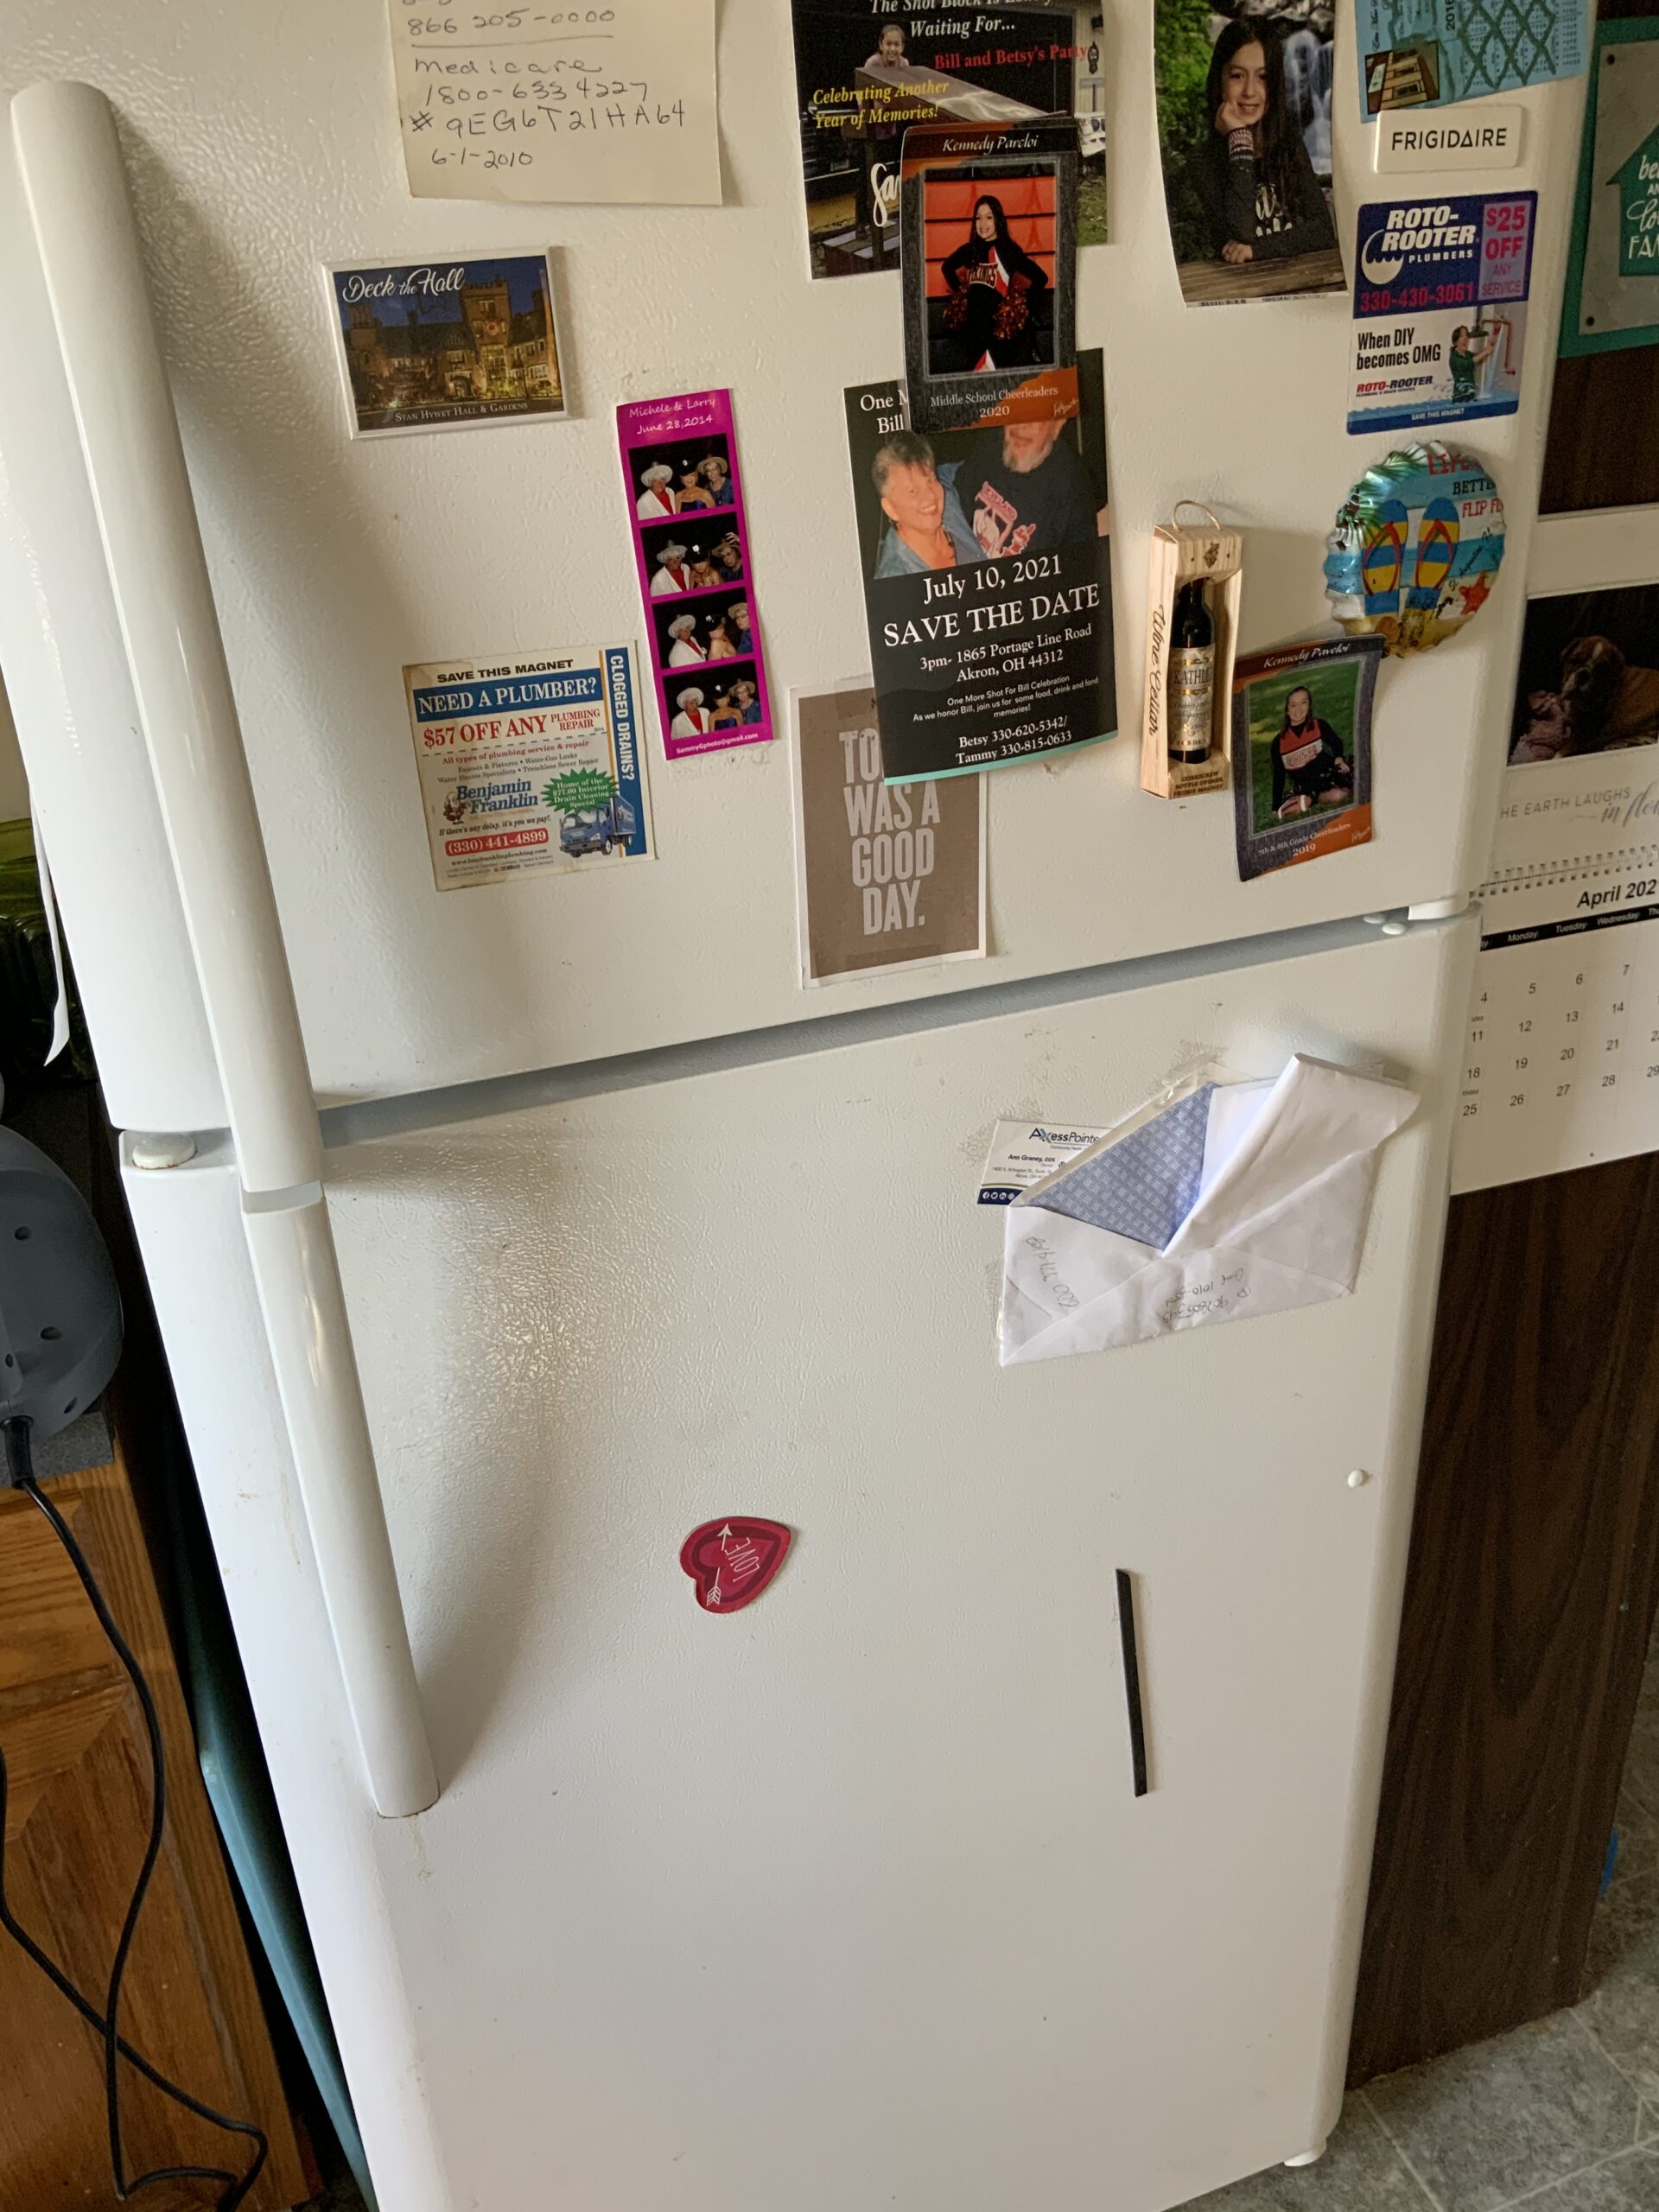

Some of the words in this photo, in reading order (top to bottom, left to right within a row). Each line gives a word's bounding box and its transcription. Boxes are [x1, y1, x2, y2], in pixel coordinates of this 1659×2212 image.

[408, 18, 457, 35] 866
[473, 8, 615, 29] 205-0000
[911, 19, 969, 38] Waiting
[975, 16, 1014, 32] For...
[934, 54, 960, 70] Bill
[964, 52, 990, 67] and
[995, 47, 1045, 67] Betsy's
[1050, 44, 1088, 60] Party
[813, 85, 891, 105] Celebrating
[894, 80, 949, 98] Another
[815, 112, 847, 129] Year
[850, 110, 864, 127] of
[869, 105, 939, 123] Memories!
[943, 136, 993, 155] Kennedy
[1391, 129, 1507, 151] FRIGIDAIRE
[432, 149, 532, 168] 6-1-2010
[1386, 205, 1459, 230] ROTO-
[1485, 207, 1526, 232] $25
[1381, 225, 1477, 251] ROOTER
[1484, 236, 1522, 260] OFF
[1408, 250, 1473, 264] PLUMBERS
[1492, 264, 1512, 276] ANY
[343, 274, 395, 302] Deck
[398, 281, 416, 296] the
[414, 268, 465, 296] Hall
[1482, 280, 1521, 296] SERVICE
[1360, 282, 1474, 312] 330-430-3061
[1357, 332, 1390, 351] When
[1393, 327, 1415, 346] DIY
[1357, 351, 1409, 371] becomes
[1413, 344, 1441, 364] OMG
[1357, 376, 1433, 393] ROTO-ROOTER
[860, 394, 893, 411] One
[931, 393, 963, 407] Middle
[965, 391, 996, 404] School
[998, 386, 1058, 401] Cheerleaders
[629, 404, 671, 418] Michele
[686, 397, 716, 410] Larry
[979, 406, 1010, 418] 2020
[637, 424, 663, 435] June
[876, 414, 905, 434] Bill
[1462, 499, 1487, 518] FLIP
[923, 574, 966, 605] July
[975, 567, 1006, 591] 10,
[1013, 554, 1062, 582] 2021
[884, 613, 961, 647] SAVE
[966, 601, 1025, 633] THE
[1031, 583, 1100, 621] DATE
[1150, 604, 1166, 666] Wine
[919, 656, 952, 671] 3pm-
[957, 647, 986, 664] 1865
[990, 639, 1034, 658] Portage
[1037, 632, 1062, 648] Line
[1065, 624, 1092, 642] Road
[957, 665, 999, 683] Akron,
[1001, 658, 1026, 674] OH
[1027, 650, 1064, 670] 44312
[1264, 651, 1309, 669] Kennedy
[437, 671, 474, 683] SAVE
[478, 666, 512, 679] THIS
[514, 659, 574, 675] MAGNET
[417, 692, 474, 715] NEED
[478, 690, 493, 708] A
[495, 677, 596, 705] PLUMBER?
[610, 654, 629, 719] CLOGGED
[947, 696, 963, 707] One
[965, 693, 985, 704] More
[986, 689, 1003, 701] Shot
[1005, 687, 1016, 697] For
[1018, 683, 1030, 695] Bill
[1031, 675, 1070, 690] Celebration
[912, 713, 924, 722] As
[937, 708, 959, 718] honor
[960, 704, 975, 715] Bill,
[976, 701, 990, 713] join
[1001, 697, 1012, 707] for
[1014, 694, 1034, 703] some
[1035, 689, 1052, 701] food,
[1054, 684, 1071, 696] drink
[1072, 682, 1084, 692] and
[1085, 676, 1099, 688] fond
[994, 703, 1031, 718] memories!
[423, 726, 455, 749] $57
[460, 720, 503, 743] OFF
[505, 715, 547, 737] ANY
[550, 709, 601, 723] PLUMBING
[559, 719, 594, 731] REPAIR
[959, 734, 988, 749] Betsy
[991, 715, 1068, 742] 330-620-5342/
[442, 757, 454, 766] All
[455, 754, 478, 765] types
[488, 748, 526, 760] plumbing
[528, 745, 556, 753] service
[565, 741, 589, 750] repair
[618, 722, 635, 780] DRAINS?
[677, 733, 759, 754] SammyGphoto@gmail.com
[956, 748, 998, 765] Tammy
[1000, 730, 1072, 757] 330-815-0633
[456, 779, 531, 799] Benjamin
[578, 784, 608, 792] Interior
[578, 791, 609, 799] Cleaning
[468, 792, 538, 814] Franklin
[569, 799, 595, 808] Special
[843, 782, 912, 836] WAS
[921, 779, 941, 826] A
[1524, 798, 1570, 816] EARTH
[1575, 787, 1630, 807] LAUGHS
[446, 827, 467, 836] there's
[469, 823, 481, 832] any
[537, 815, 551, 824] pay!
[448, 840, 483, 854] (330)
[486, 831, 546, 849] 441-4899
[1293, 844, 1316, 856] 2019
[851, 827, 936, 888] GOOD
[1577, 885, 1621, 908] April
[863, 879, 925, 936] DAY.
[1555, 921, 1586, 933] Tuesday
[1598, 912, 1639, 925] Wednesday
[1508, 931, 1538, 943] Monday
[1529, 982, 1536, 995] 5
[1576, 974, 1583, 985] 6
[1567, 1011, 1579, 1023] 13
[1611, 1002, 1624, 1014] 14
[1471, 1031, 1483, 1042] 11
[1519, 1020, 1532, 1033] 12
[1560, 1047, 1574, 1060] 20
[1606, 1039, 1618, 1051] 21
[1468, 1067, 1480, 1079] 18
[1516, 1058, 1528, 1069] 19
[1556, 1084, 1571, 1096] 27
[1602, 1075, 1615, 1087] 28
[1462, 1103, 1477, 1116] 25
[1510, 1094, 1523, 1107] 26
[724, 1537, 760, 1583] LOVE
